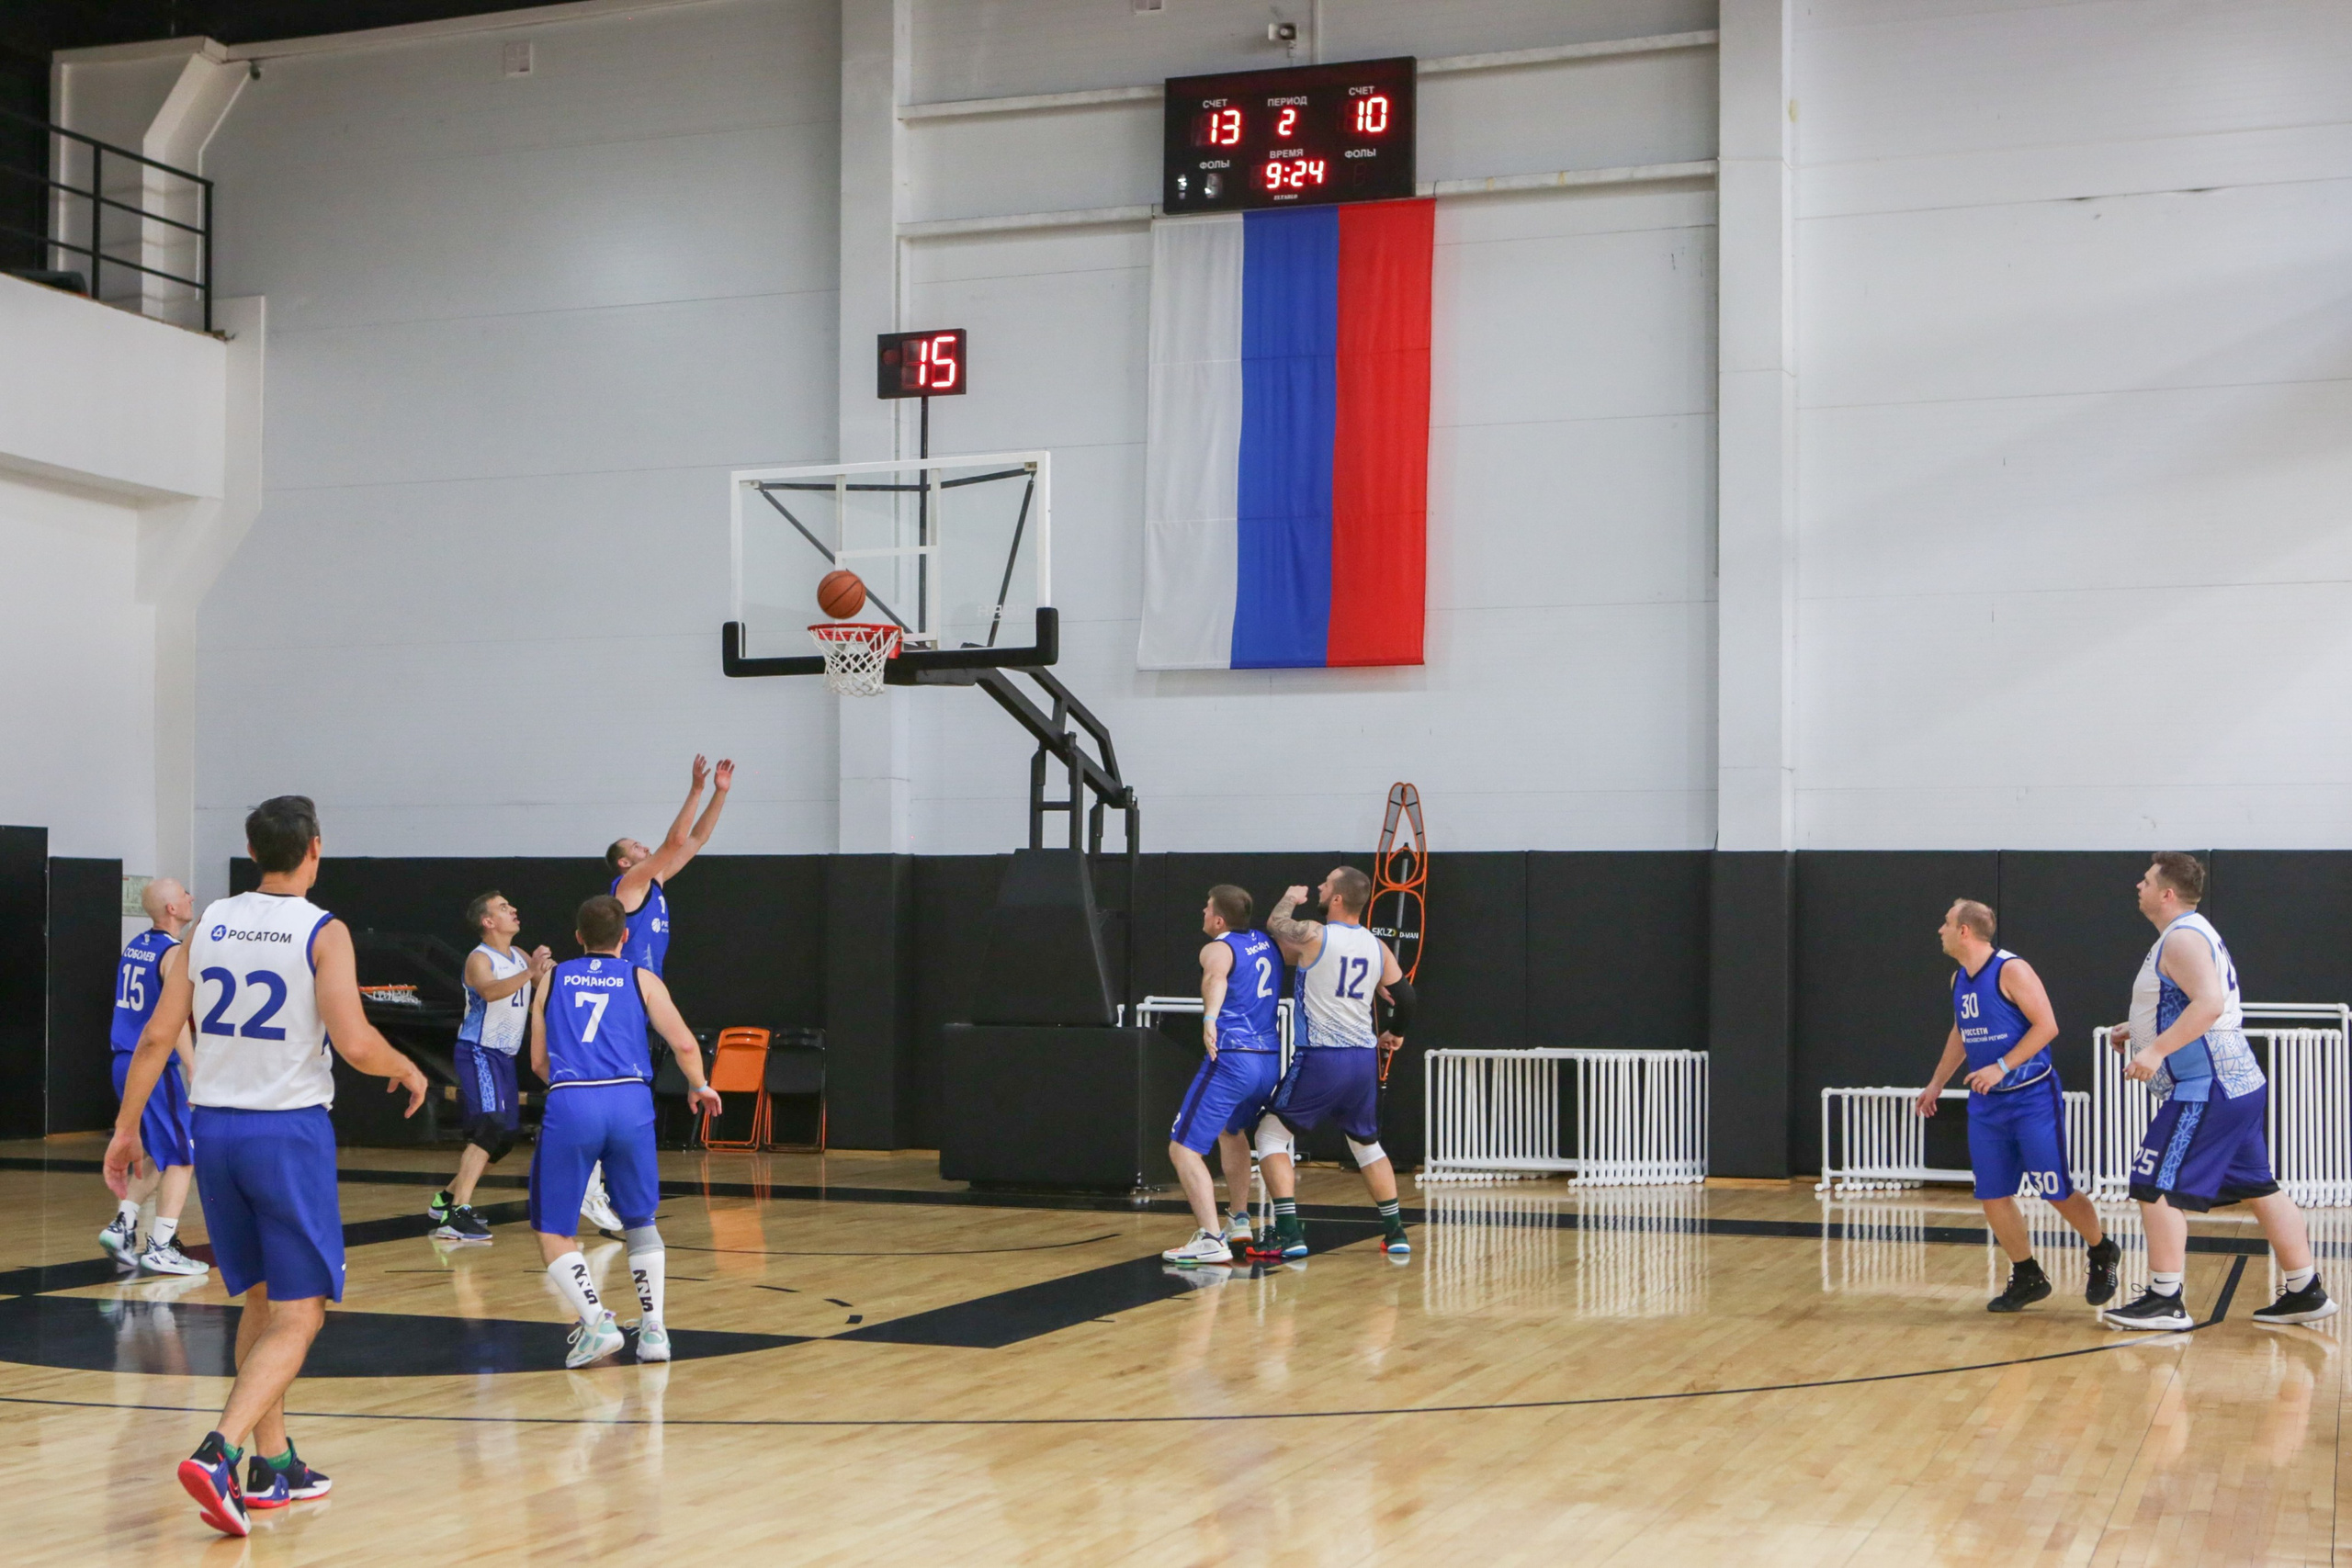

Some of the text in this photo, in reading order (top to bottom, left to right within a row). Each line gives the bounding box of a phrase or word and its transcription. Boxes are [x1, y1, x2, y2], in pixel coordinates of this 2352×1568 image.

[1203, 98, 1228, 108] СЧЕТ
[1267, 96, 1307, 107] ПЕРИОД
[1348, 85, 1375, 96] СЧЕТ
[1210, 109, 1240, 144] 13
[1278, 108, 1295, 136] 2
[1356, 96, 1387, 133] 10
[1199, 159, 1231, 170] ФОЛЫ
[1269, 148, 1304, 159] ВРЕМЯ
[1344, 148, 1377, 159] ФОЛЫ
[1266, 160, 1325, 189] 9:24
[919, 335, 956, 388] 15
[228, 929, 292, 943] РОСАТОМ
[116, 964, 146, 1011] 15
[563, 975, 625, 987] РОМАНОВ
[1255, 956, 1273, 998] 2
[1335, 955, 1369, 999] 12
[199, 966, 288, 1041] 22
[575, 991, 609, 1043] 7
[1960, 992, 1980, 1020] 30
